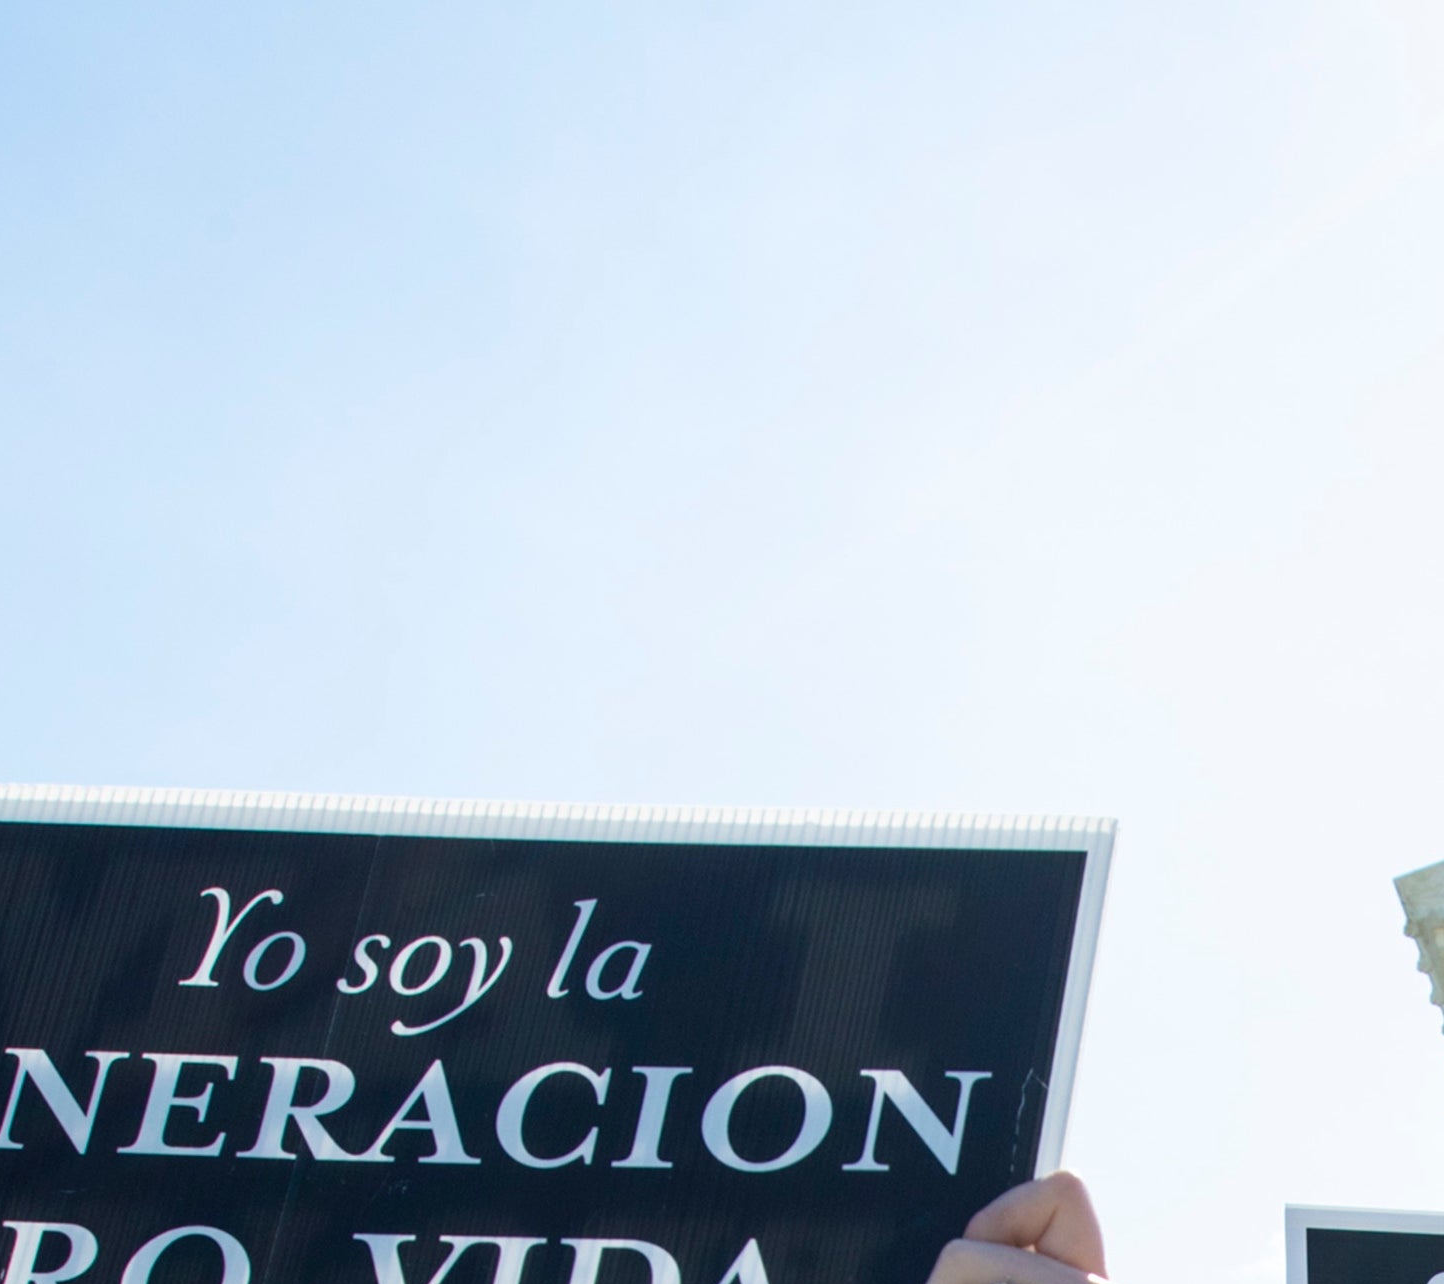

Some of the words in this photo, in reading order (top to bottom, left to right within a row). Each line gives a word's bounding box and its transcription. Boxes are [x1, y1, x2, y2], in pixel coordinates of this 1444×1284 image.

[178, 887, 306, 991] Yo
[337, 930, 511, 1035] soy
[545, 899, 652, 1001] la
